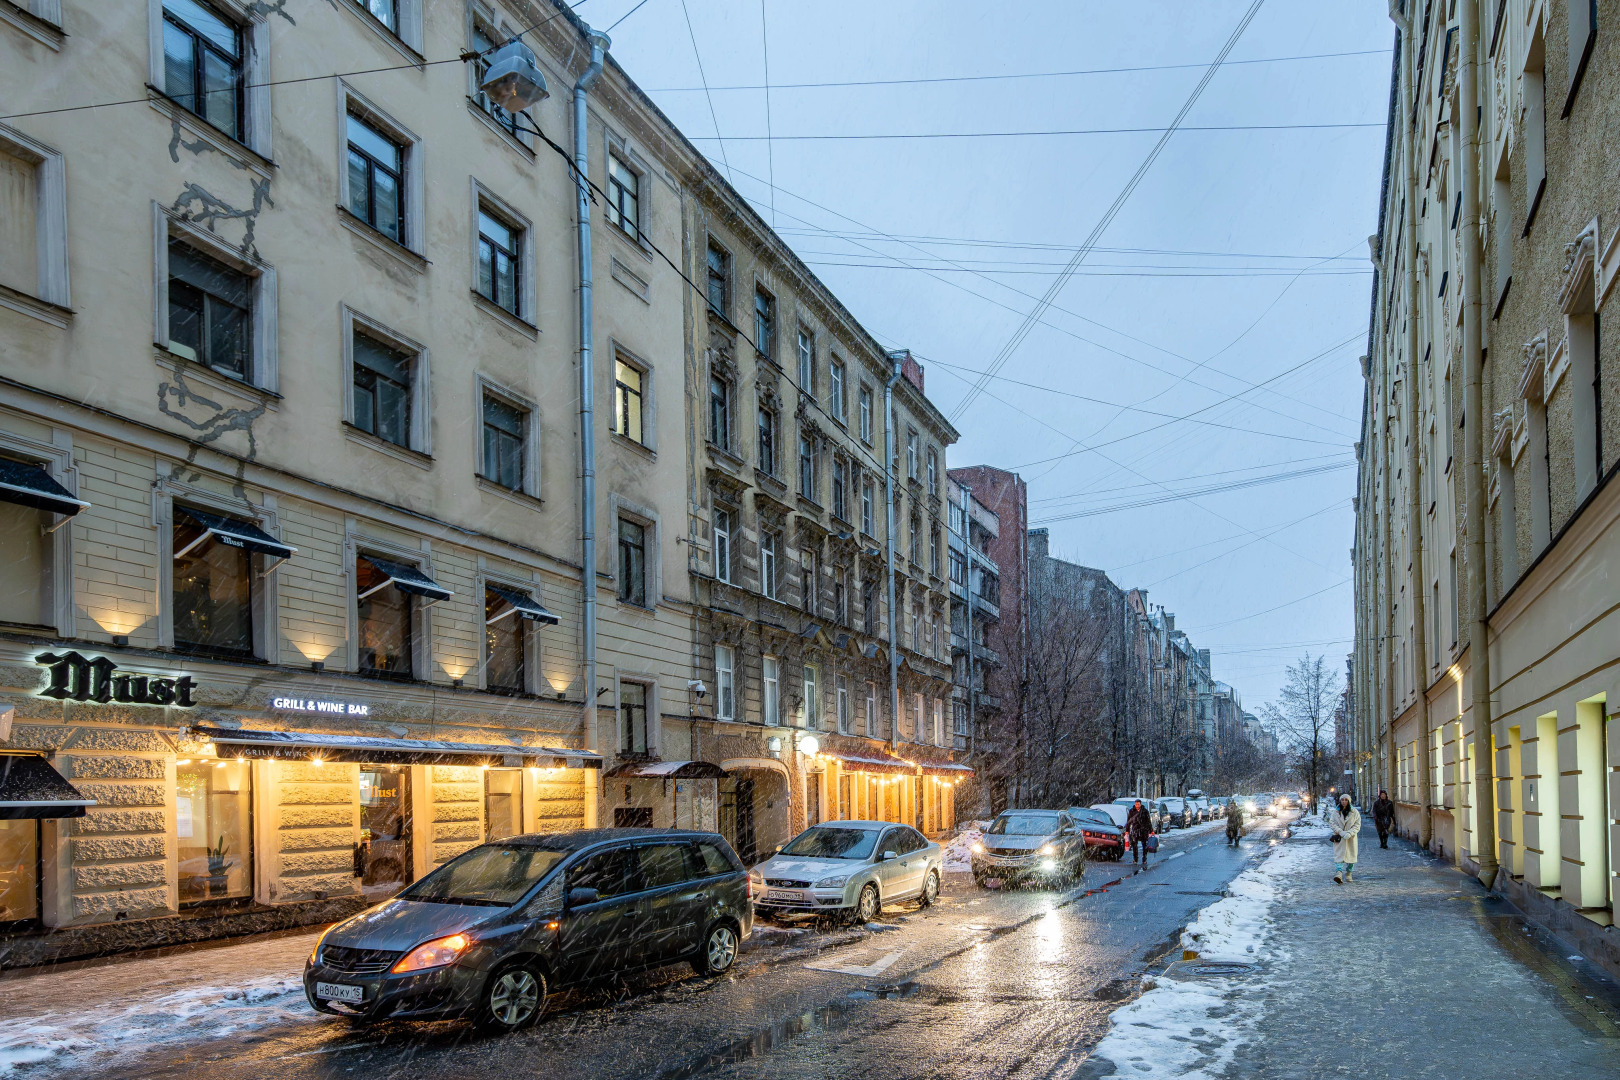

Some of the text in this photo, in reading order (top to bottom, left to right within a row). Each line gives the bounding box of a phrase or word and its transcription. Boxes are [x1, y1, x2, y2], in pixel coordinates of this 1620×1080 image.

[221, 535, 244, 548] Must
[35, 651, 198, 707] Must
[274, 698, 368, 715] GRILL & WINE BAR
[245, 749, 272, 757] GRILL
